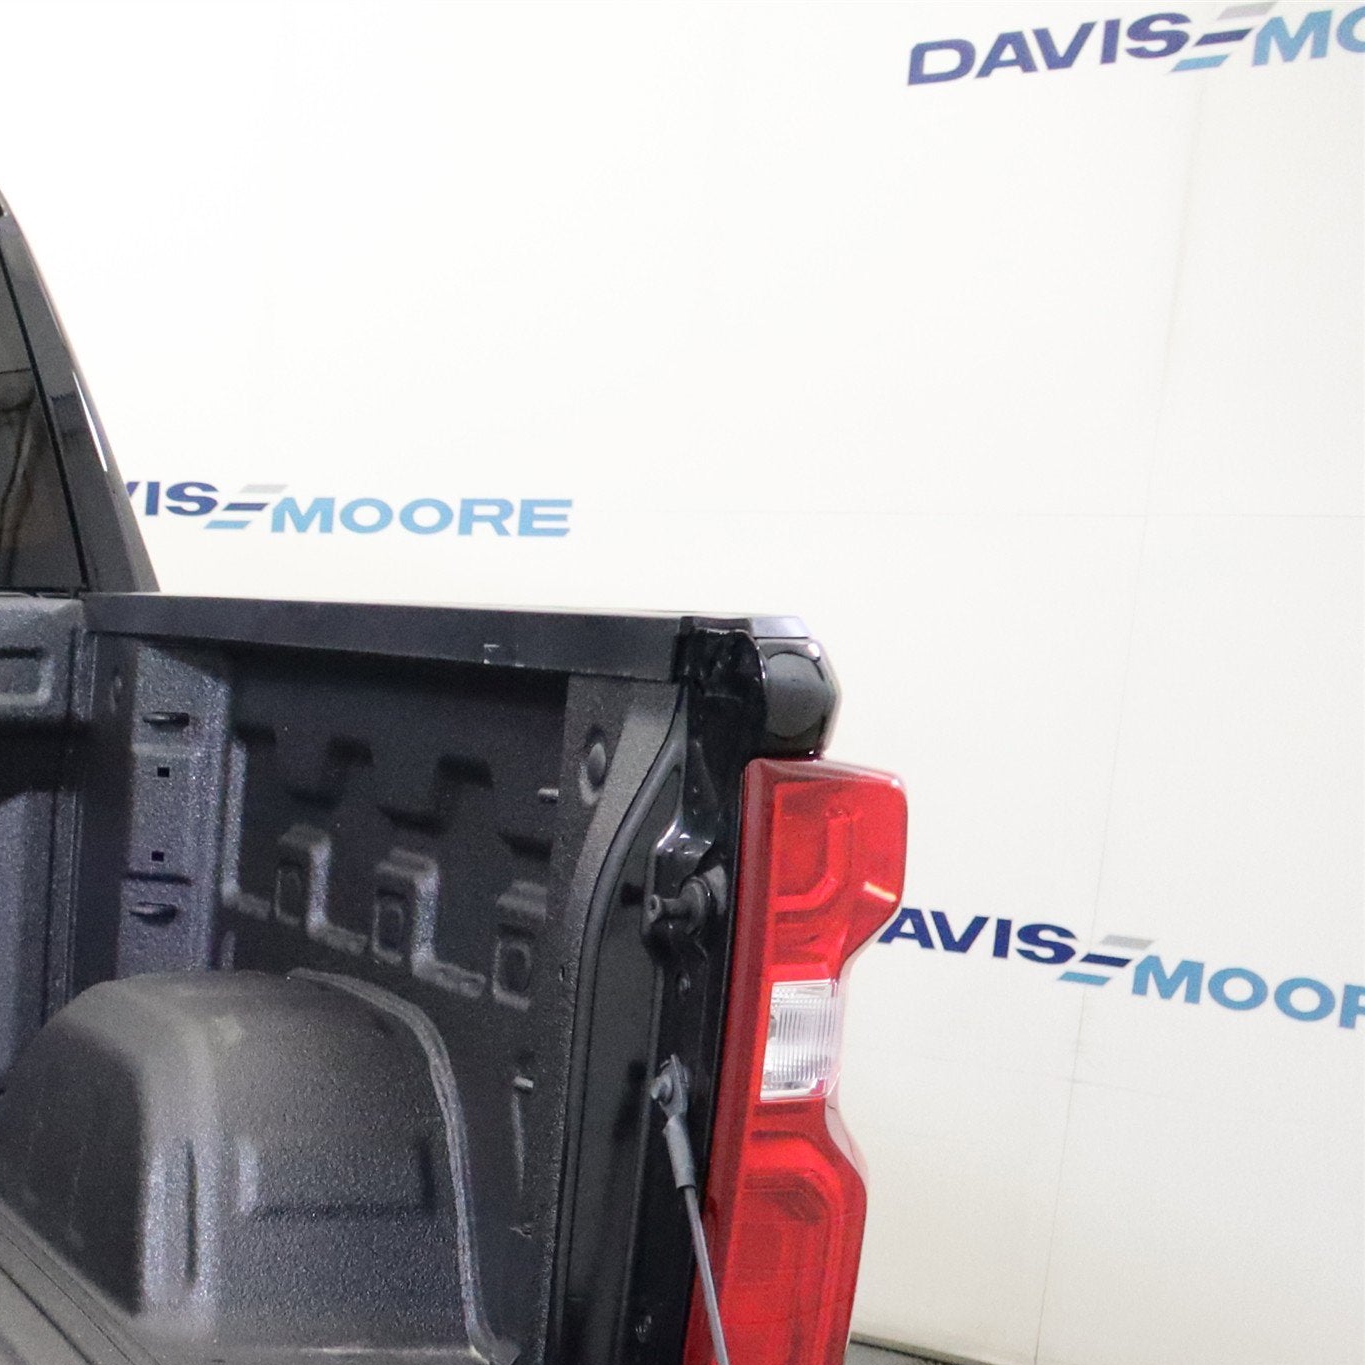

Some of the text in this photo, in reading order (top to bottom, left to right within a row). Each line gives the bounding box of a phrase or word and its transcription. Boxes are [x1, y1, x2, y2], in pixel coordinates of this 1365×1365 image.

[908, 12, 1192, 86] DAVIS
[126, 481, 573, 538] IS MOORE
